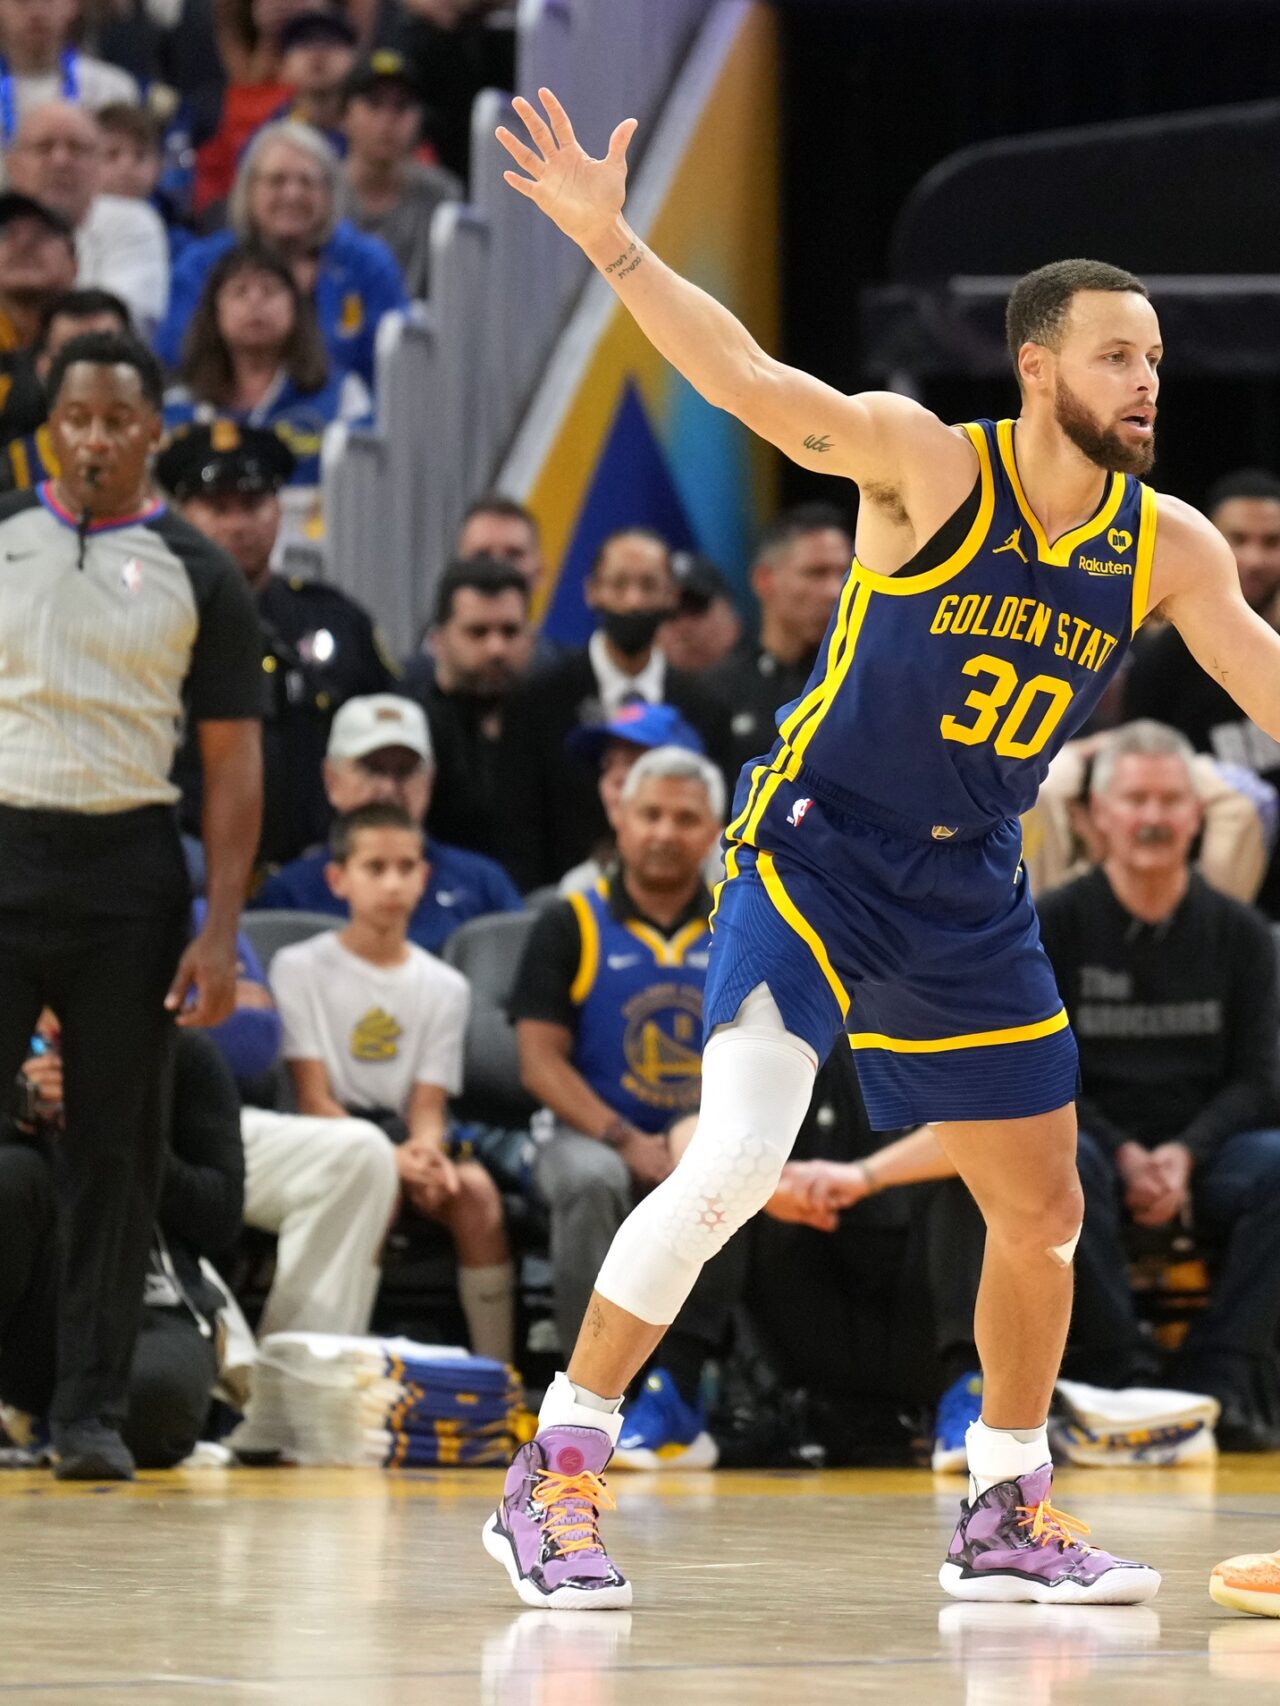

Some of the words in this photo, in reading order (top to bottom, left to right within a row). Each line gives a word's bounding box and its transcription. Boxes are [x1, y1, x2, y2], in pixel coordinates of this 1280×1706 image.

[1078, 555, 1133, 576] Rakuten
[1112, 534, 1127, 547] DM
[929, 594, 1052, 648] GOLDEN
[1053, 611, 1119, 673] STAT
[939, 653, 1075, 760] 30
